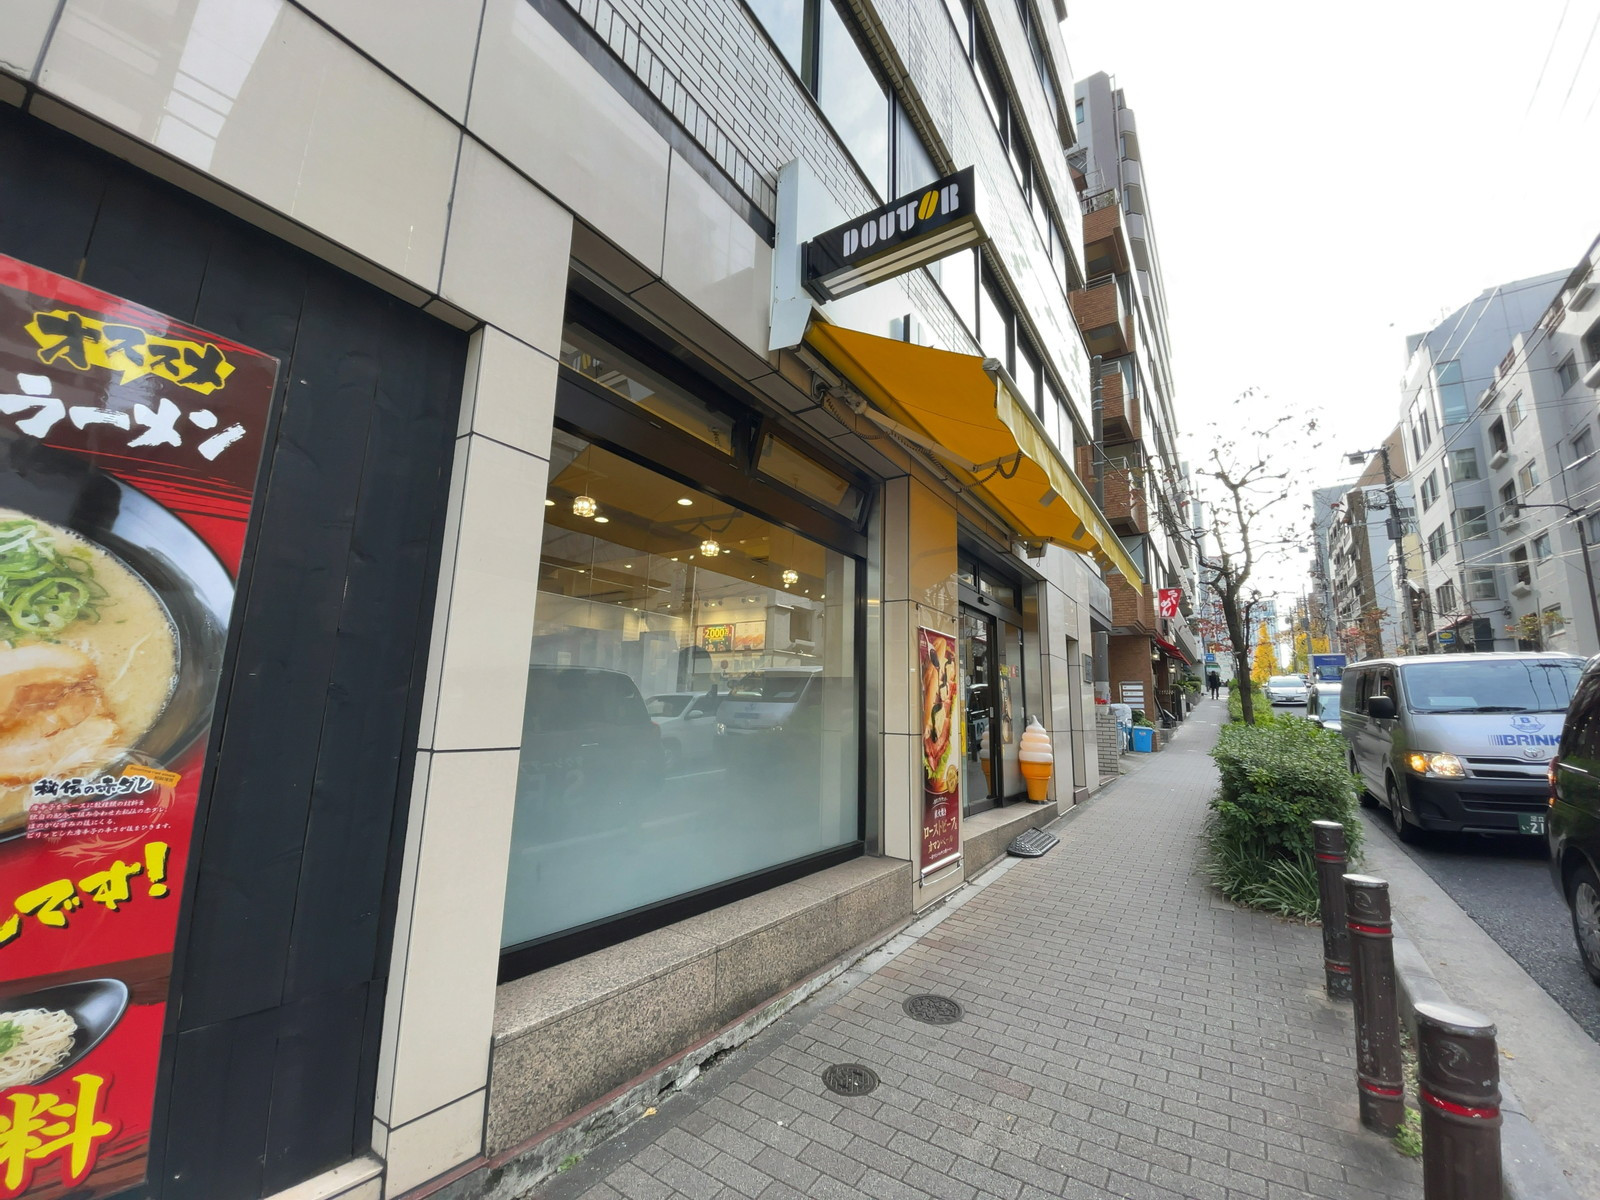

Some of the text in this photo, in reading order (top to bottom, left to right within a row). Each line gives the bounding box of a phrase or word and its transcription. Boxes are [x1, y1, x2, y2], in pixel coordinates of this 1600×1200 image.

[843, 183, 959, 258] DOUTOR
[34, 311, 225, 389] オススメ
[0, 373, 246, 461] ラーメン
[33, 775, 154, 797] 秘伝の赤ダレ
